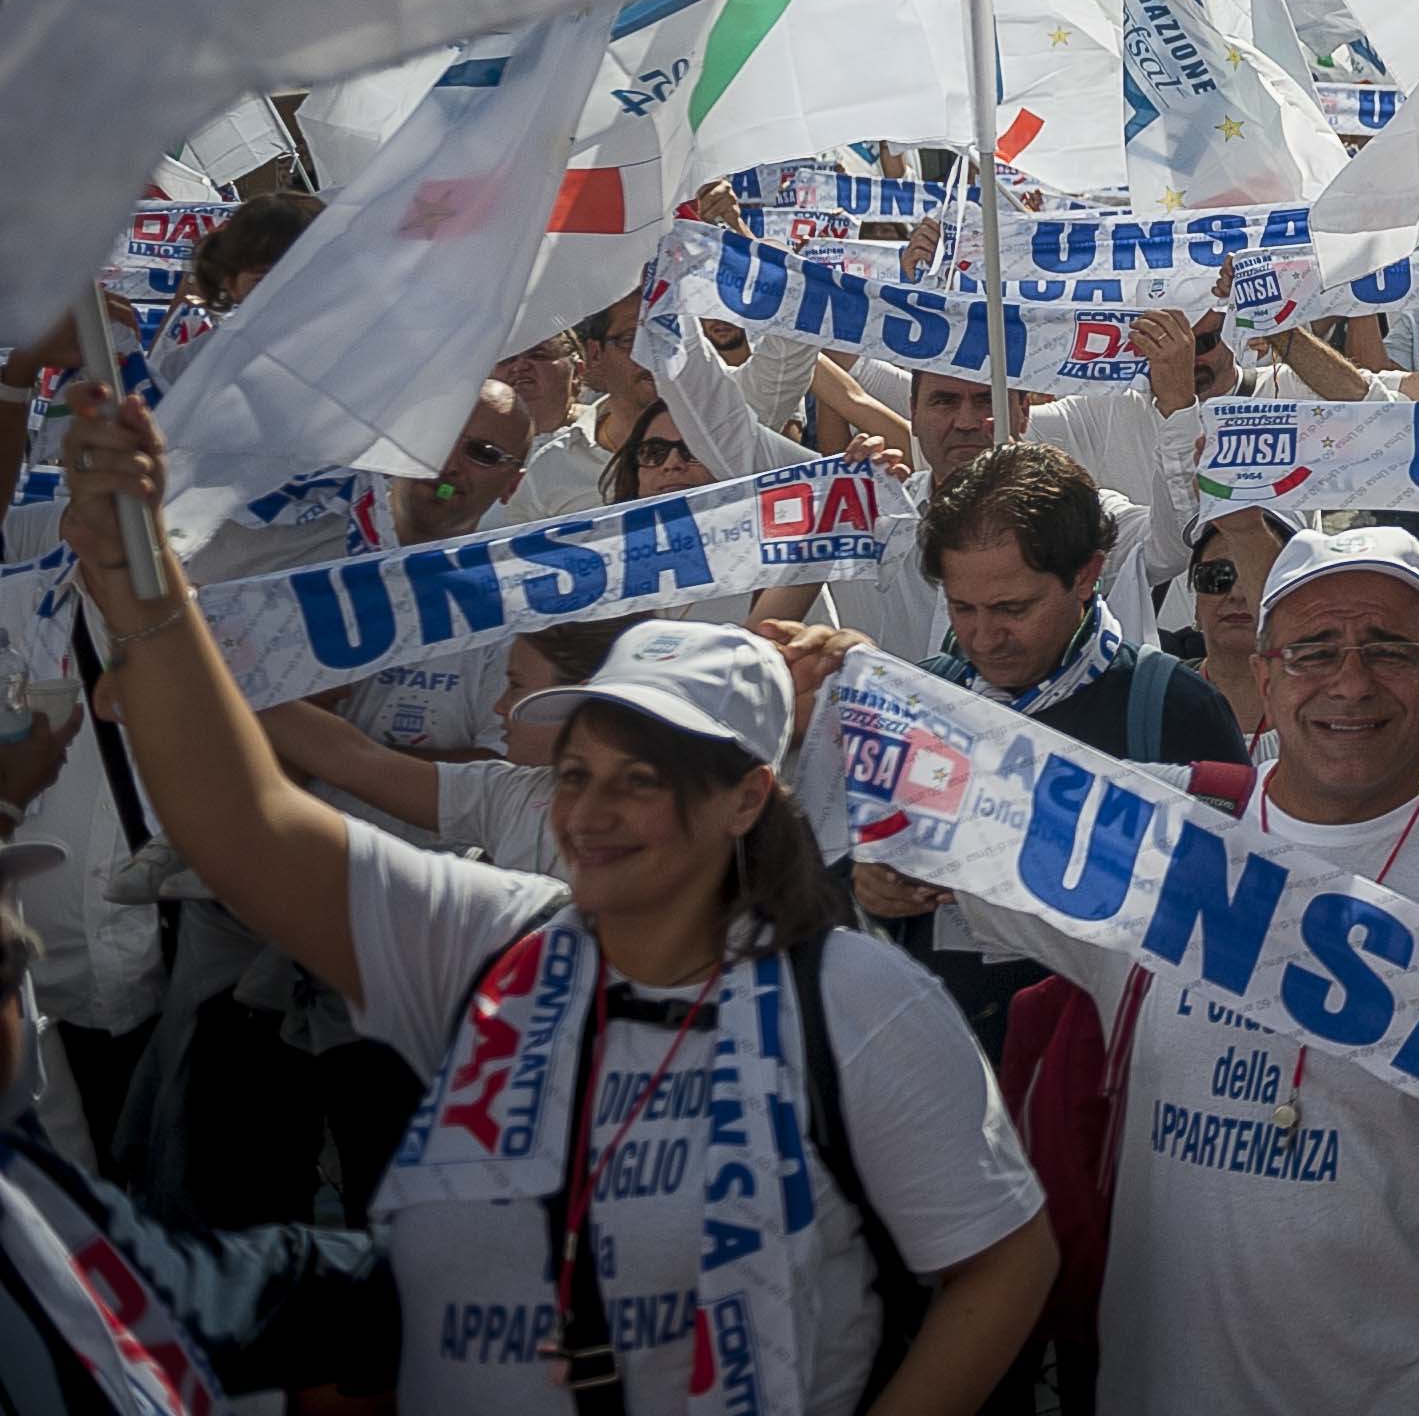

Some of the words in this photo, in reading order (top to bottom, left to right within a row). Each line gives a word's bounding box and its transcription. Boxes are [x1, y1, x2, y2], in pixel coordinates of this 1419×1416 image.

[1124, 9, 1183, 93] fsal
[129, 242, 194, 259] 11.10.2
[1032, 208, 1312, 275] UNSA
[717, 230, 1028, 379] UNSA
[1236, 276, 1279, 305] UNSA
[1060, 361, 1150, 382] 11.10.2
[1214, 404, 1298, 416] FEDERAZIONE
[1217, 433, 1291, 466] UNSA
[758, 457, 874, 489] CONTRA
[763, 537, 876, 563] 11.10.20
[291, 497, 714, 670] UNSA
[377, 667, 460, 691] STAFF
[844, 735, 903, 790] NSA
[503, 928, 580, 1158] CONTRATTO
[1212, 1047, 1281, 1104] della
